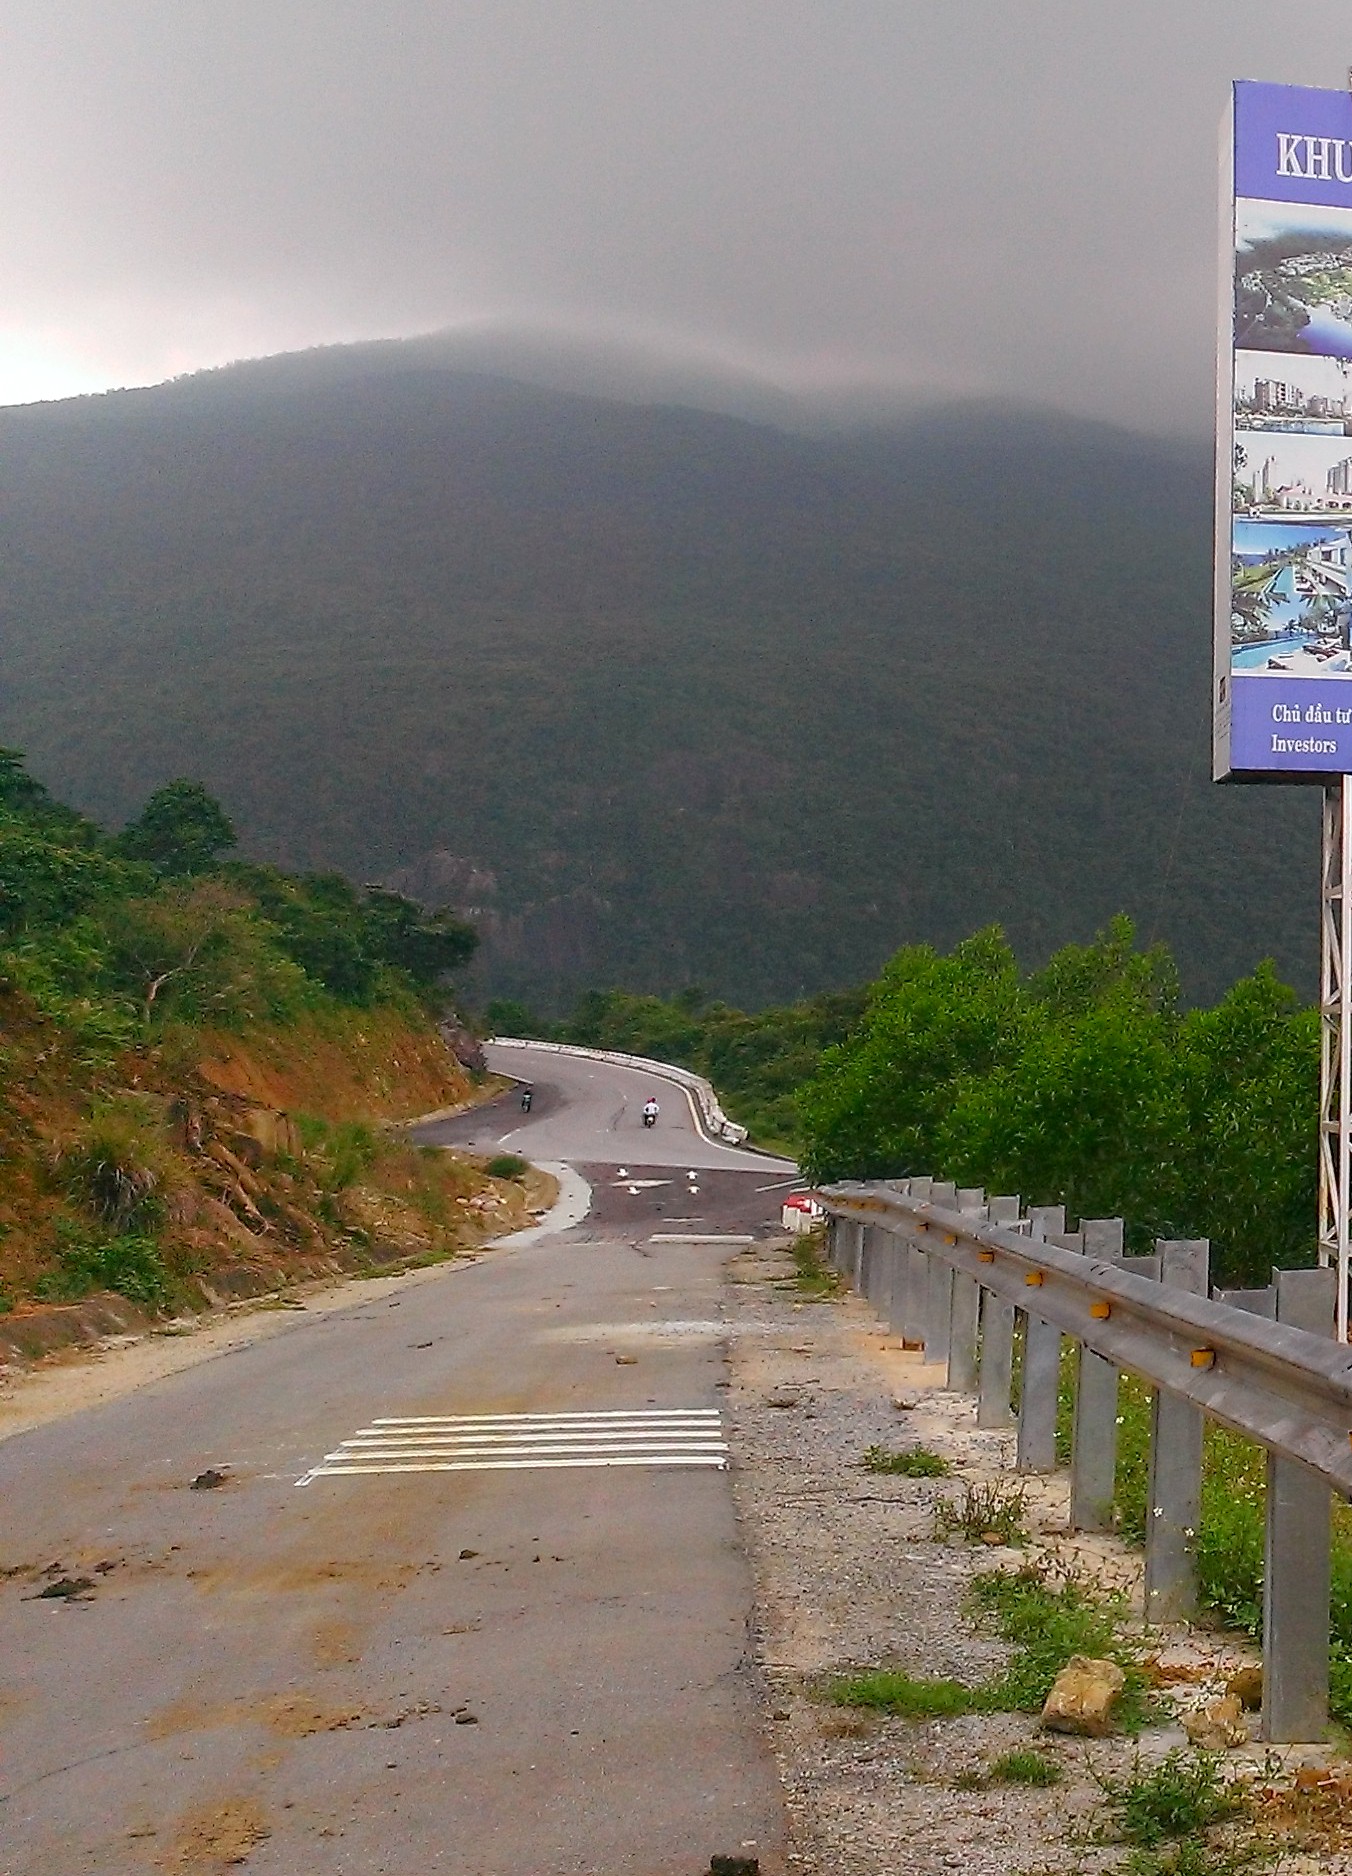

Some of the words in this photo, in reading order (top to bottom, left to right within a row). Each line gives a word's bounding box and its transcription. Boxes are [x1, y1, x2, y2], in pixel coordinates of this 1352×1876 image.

[1272, 703, 1301, 723] Chủ
[1335, 706, 1352, 724] tư
[1270, 733, 1337, 754] Investors
